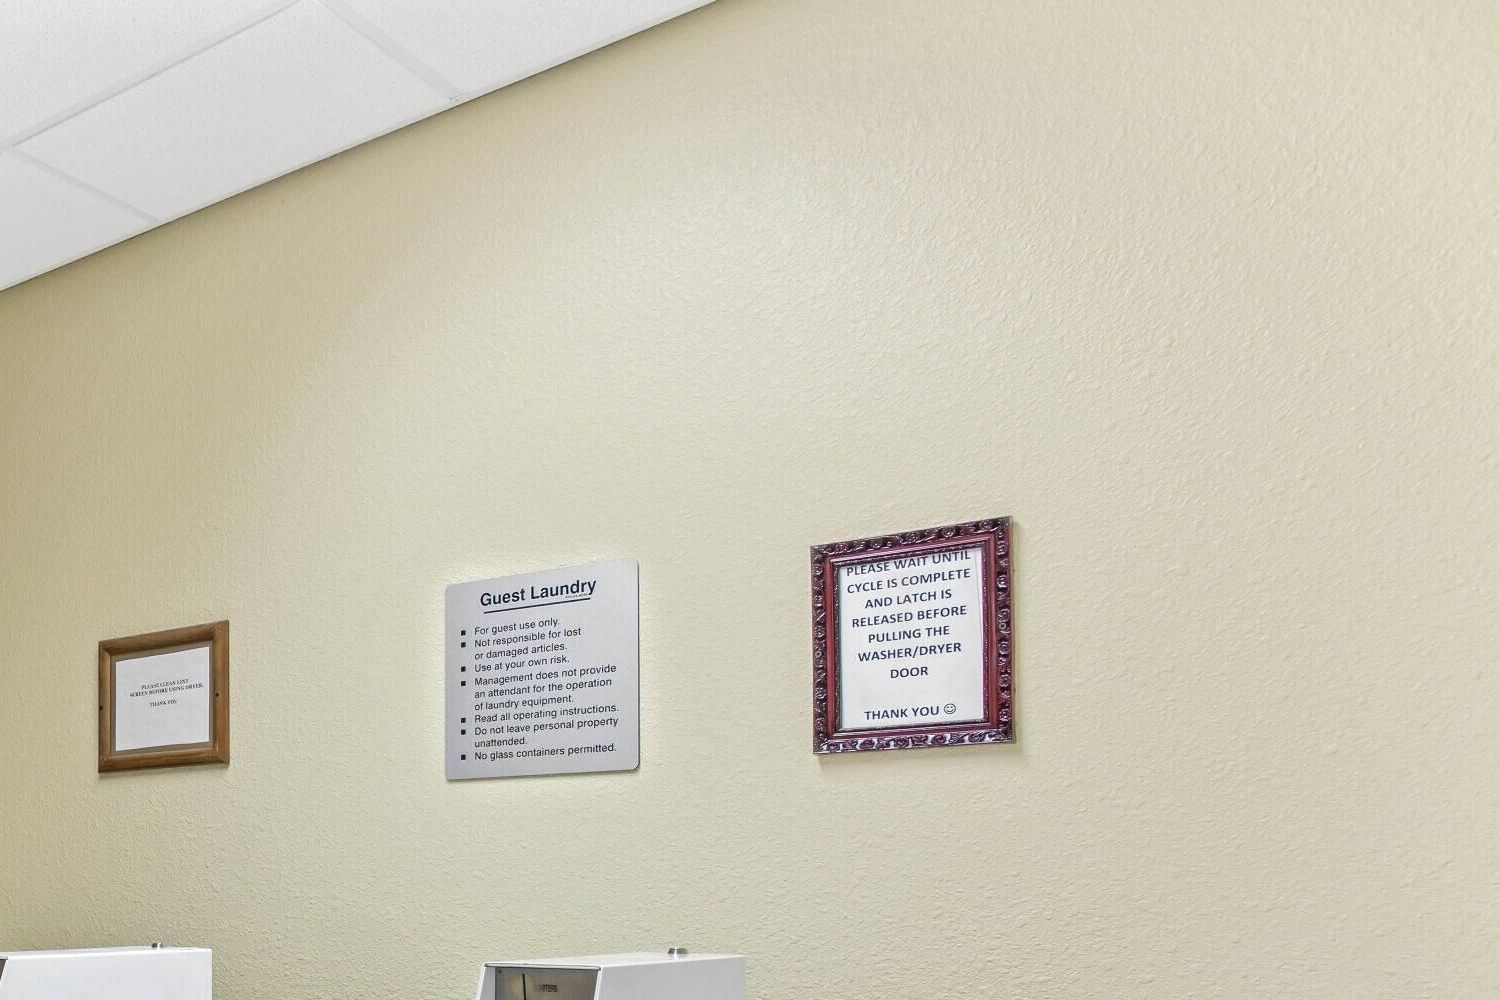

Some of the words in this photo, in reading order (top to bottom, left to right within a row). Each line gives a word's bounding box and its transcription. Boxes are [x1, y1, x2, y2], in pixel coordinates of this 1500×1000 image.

[846, 563, 890, 576] PLEASE
[894, 557, 927, 571] WAIT
[932, 550, 971, 564] UNTIL
[847, 580, 883, 594] CYCLE
[887, 579, 897, 588] IS
[901, 569, 971, 587] COMPLETE
[480, 588, 525, 607] Guest
[531, 579, 597, 599] Laundry
[865, 597, 892, 609] AND
[897, 592, 936, 605] LATCH
[941, 589, 952, 599] IS
[852, 613, 913, 628] RELEASED
[917, 606, 967, 620] BEFORE
[475, 627, 488, 635] For
[492, 623, 516, 635] guest
[538, 618, 560, 627] only.
[868, 629, 921, 643] PULLING
[926, 625, 950, 637] THE
[475, 639, 490, 647] Not
[493, 632, 545, 646] responsible
[549, 630, 561, 638] for
[564, 628, 581, 637] lost
[486, 646, 528, 658] damaged
[532, 643, 567, 653] articles.
[858, 642, 962, 662] WASHER/DRYER
[475, 664, 491, 672] Use
[506, 661, 525, 671] your
[551, 655, 569, 664] risk.
[890, 666, 929, 679] DOOR
[475, 674, 532, 686] Management
[536, 672, 558, 680] does
[562, 669, 576, 677] not
[580, 664, 616, 678] provide
[488, 686, 530, 697] attendant
[549, 683, 562, 691] the
[566, 679, 612, 691] operation
[475, 702, 483, 710] of
[486, 700, 519, 709] laundry
[522, 695, 573, 708] equipment.
[475, 714, 497, 723] Read
[501, 713, 510, 721] all
[513, 710, 557, 721] operating
[560, 705, 618, 716] instructions.
[864, 706, 908, 720] THANK
[911, 706, 939, 717] YOU
[475, 727, 487, 735] Do
[490, 726, 504, 734] not
[534, 720, 573, 733] personal
[578, 718, 618, 729] property
[475, 737, 527, 747] unattended.
[475, 752, 487, 760] No
[490, 751, 513, 761] glass
[517, 748, 564, 757] containers
[568, 743, 616, 756] permitted.
